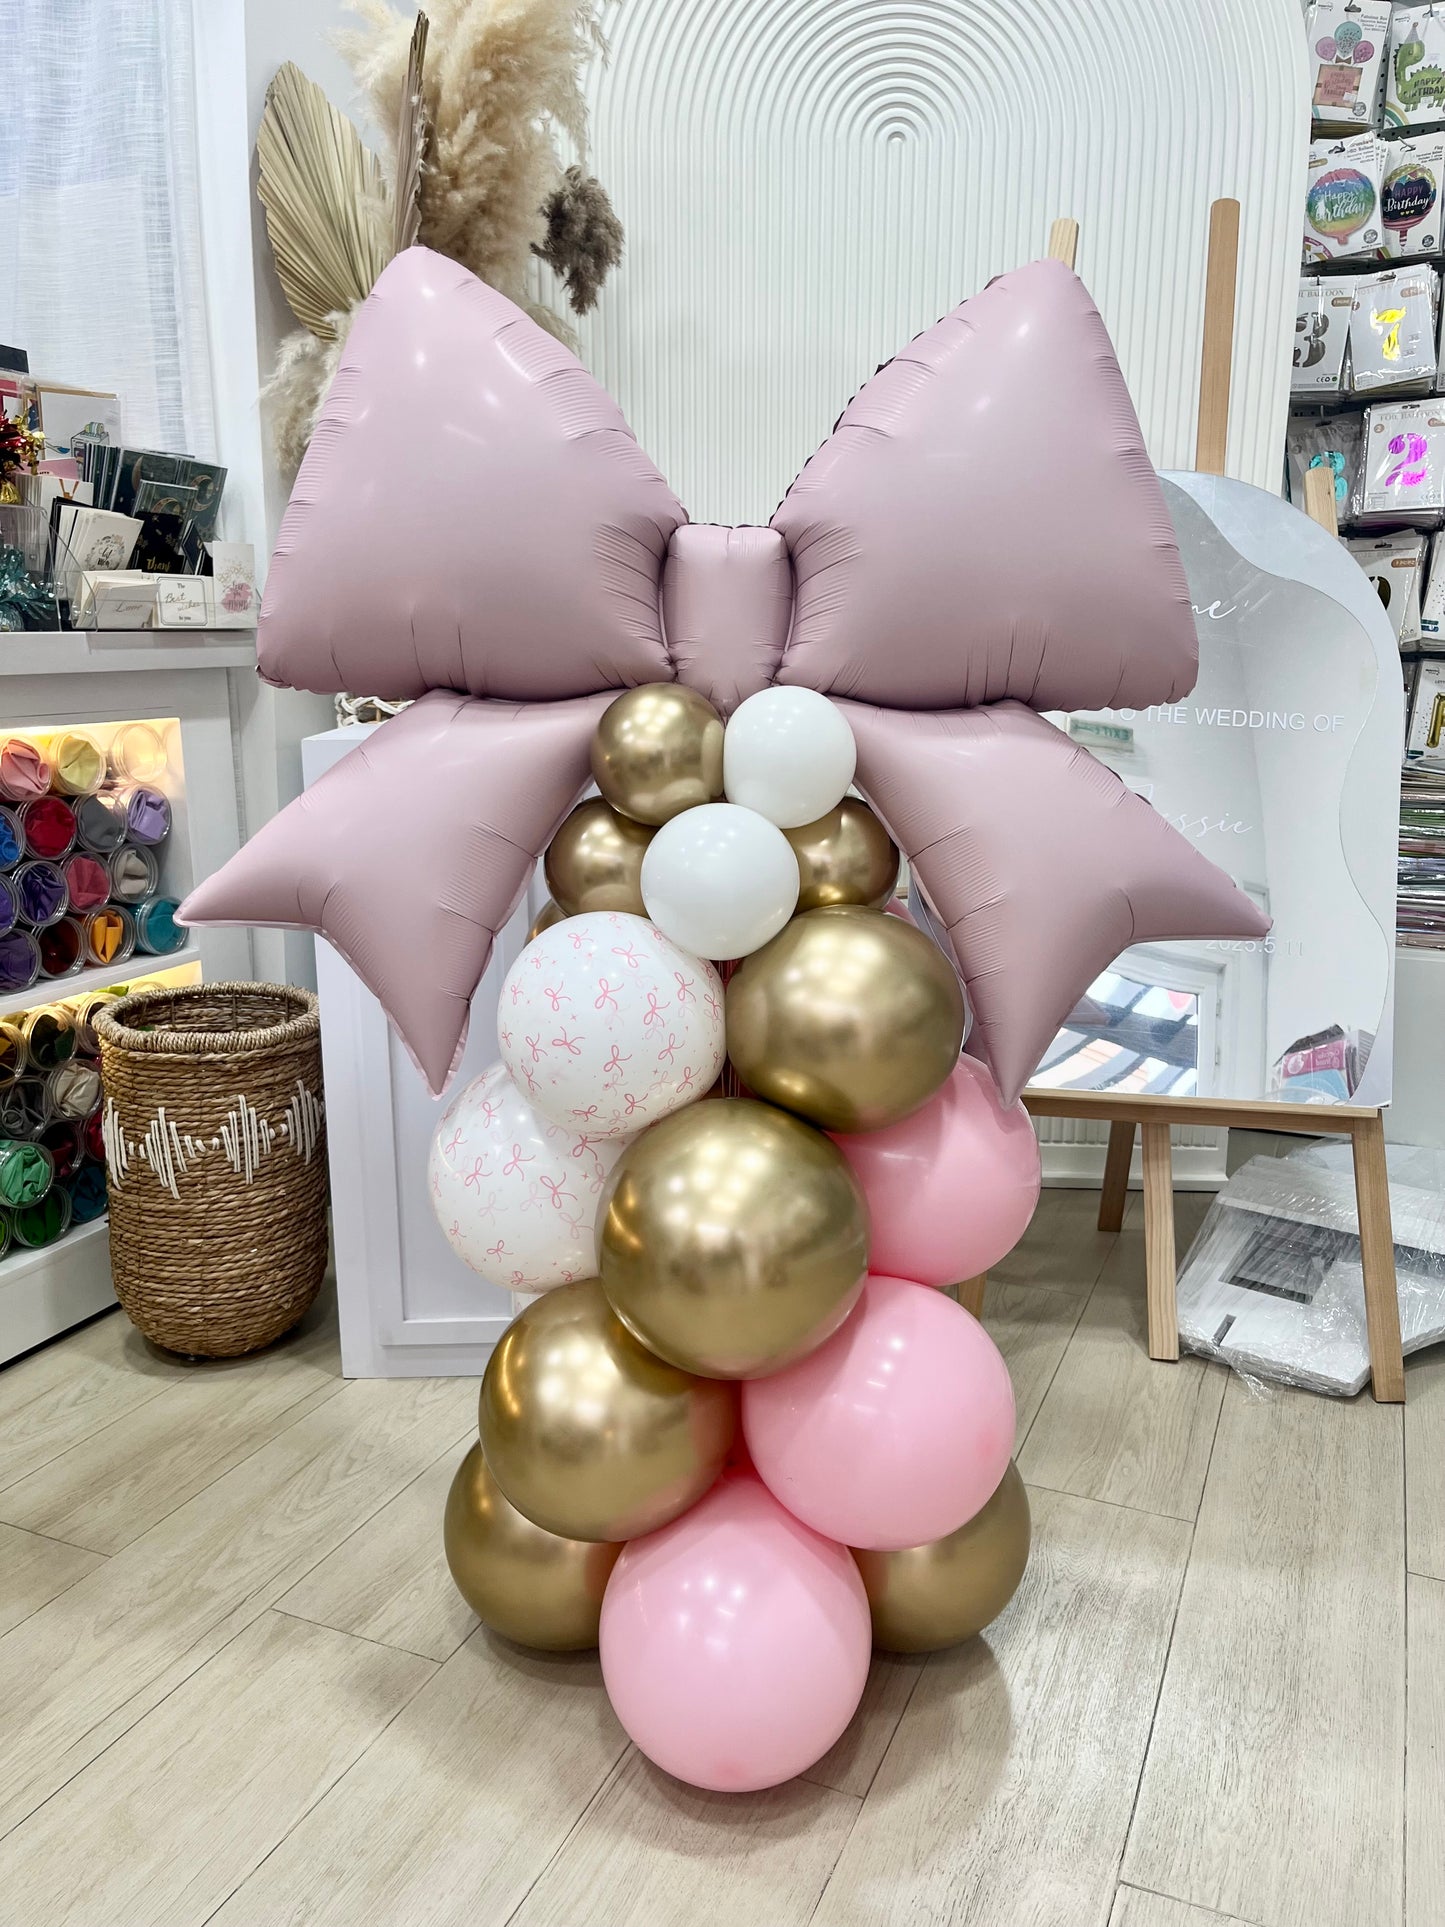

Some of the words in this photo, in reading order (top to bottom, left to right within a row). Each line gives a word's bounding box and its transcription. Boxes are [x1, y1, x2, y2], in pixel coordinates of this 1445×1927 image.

[1413, 77, 1443, 89] HAPPY
[1324, 190, 1355, 206] Happy
[1383, 191, 1433, 213] Birthday
[1394, 185, 1424, 199] HAPPY
[1292, 311, 1330, 368] 3
[1370, 306, 1407, 361] 7
[1385, 432, 1428, 487] 2
[1146, 705, 1188, 724] THE
[1194, 707, 1306, 731] WEDDING
[1312, 714, 1346, 733] OF
